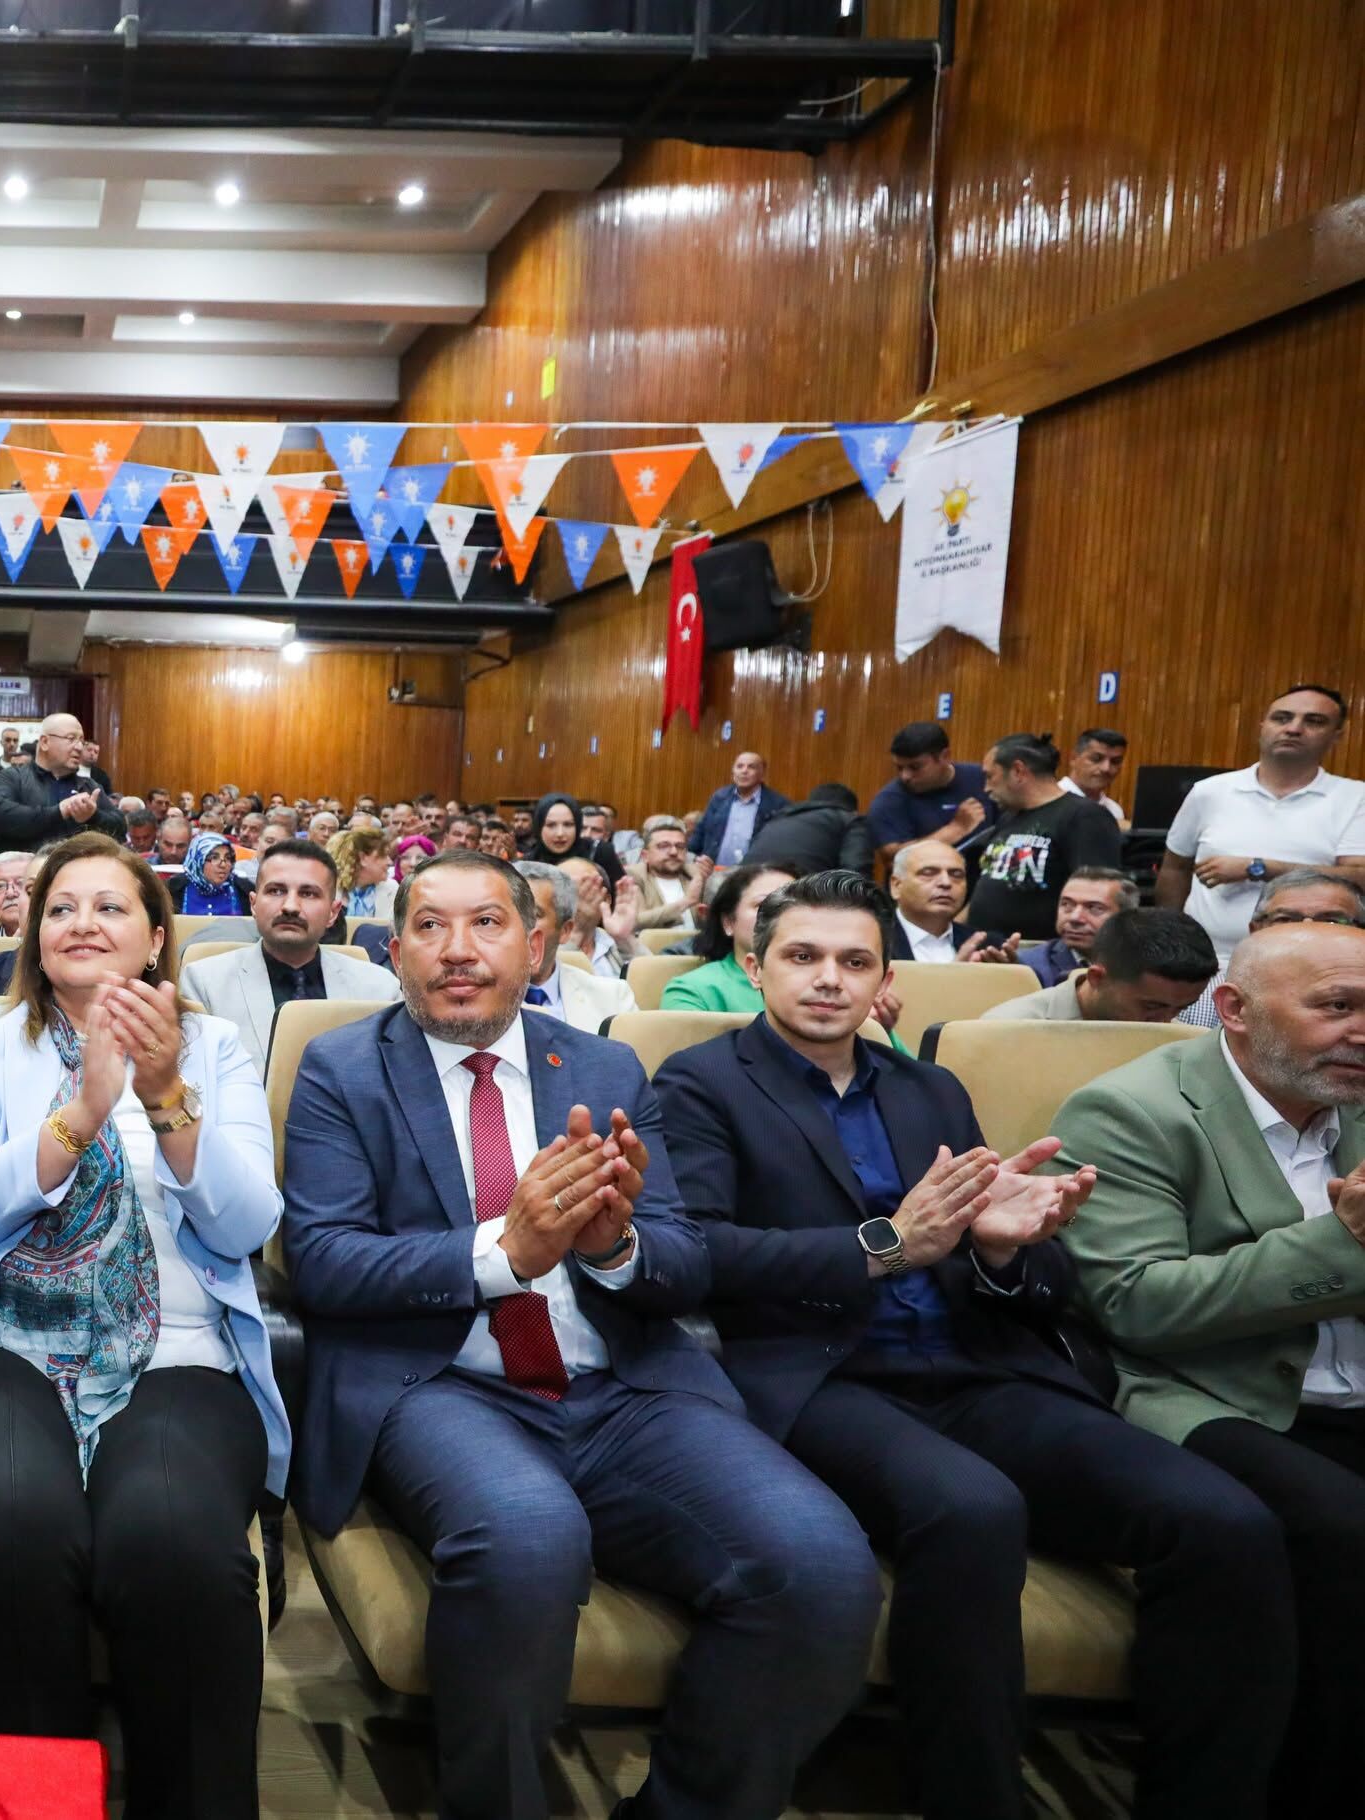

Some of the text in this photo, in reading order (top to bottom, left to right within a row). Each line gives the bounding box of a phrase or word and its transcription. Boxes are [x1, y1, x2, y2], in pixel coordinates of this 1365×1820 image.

[1099, 672, 1117, 702] D
[938, 693, 951, 719] E
[814, 709, 825, 731] F
